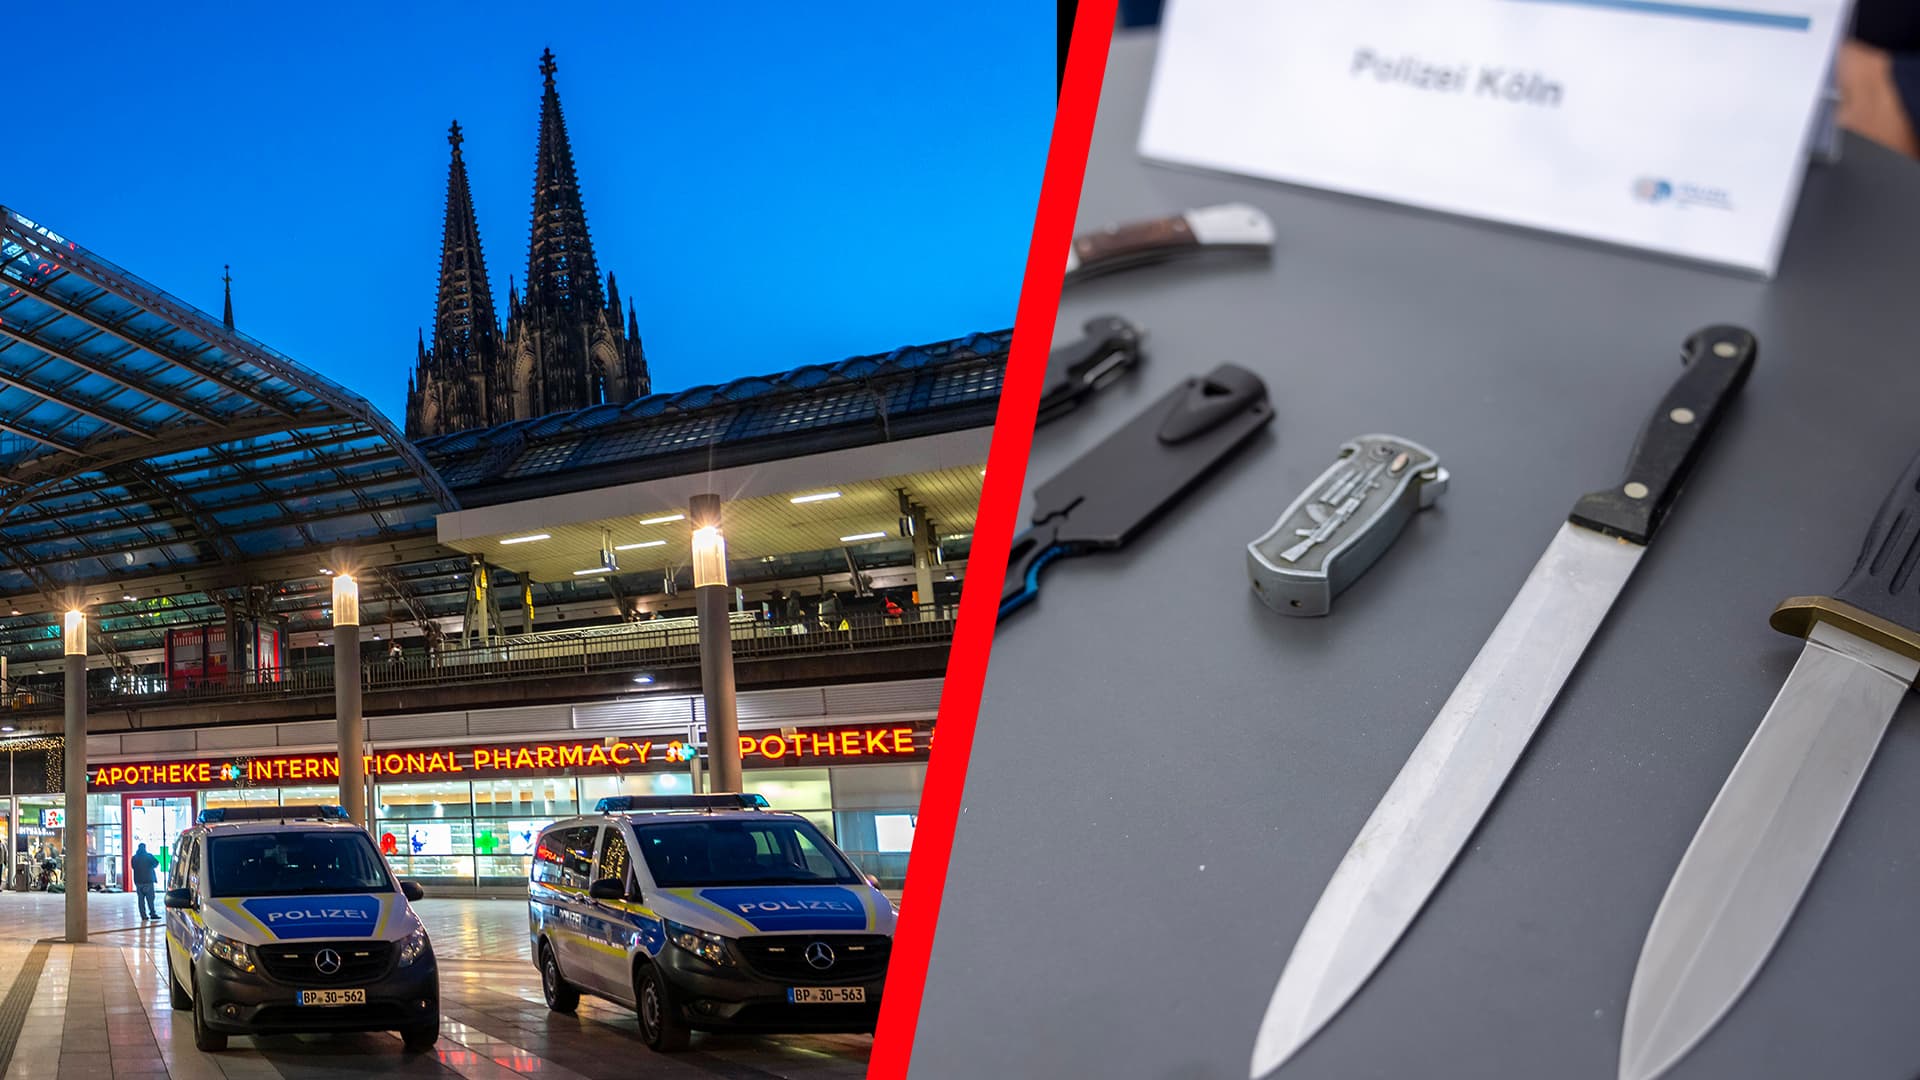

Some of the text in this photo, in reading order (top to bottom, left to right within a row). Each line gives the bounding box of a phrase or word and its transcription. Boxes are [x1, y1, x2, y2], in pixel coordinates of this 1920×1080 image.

[1352, 48, 1564, 107] Polizei Köln
[738, 728, 915, 760] POTHEKE
[95, 742, 652, 786] APOTHEKE INTERNTIONAL PHARMACY
[267, 909, 368, 922] POLIZEI
[738, 900, 854, 912] POLIZEI
